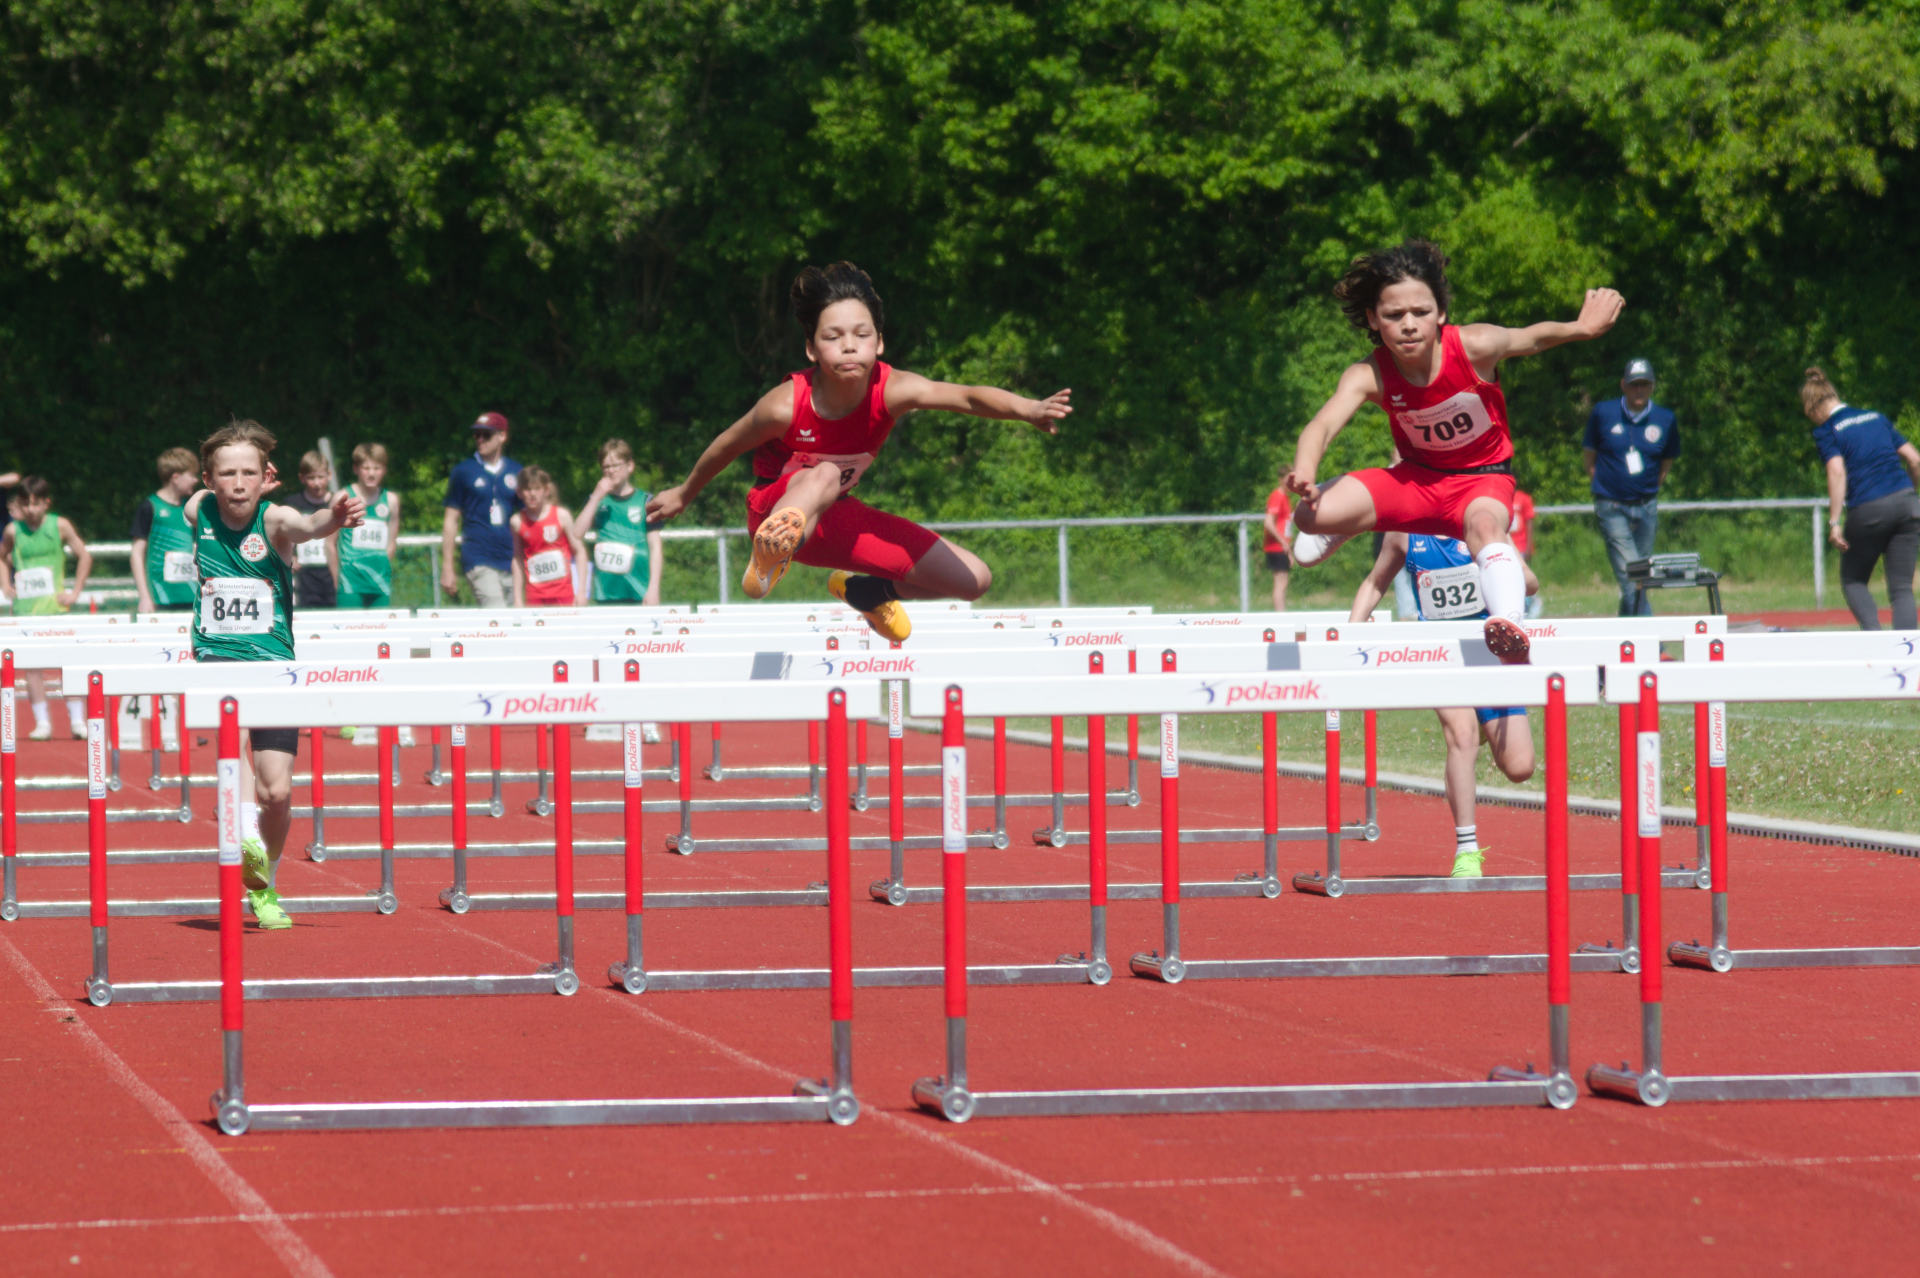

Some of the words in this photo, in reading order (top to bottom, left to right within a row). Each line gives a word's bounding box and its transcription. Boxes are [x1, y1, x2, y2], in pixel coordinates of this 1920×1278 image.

[1413, 412, 1474, 442] 709
[213, 596, 260, 622] 844
[1431, 582, 1478, 608] 932
[841, 656, 916, 677] polanik
[1376, 646, 1449, 667] polanik
[305, 666, 380, 687] polanik
[502, 692, 598, 719] polanik
[891, 691, 900, 726] polanik
[1226, 680, 1321, 706] polanik
[1163, 717, 1175, 763] polanik
[1712, 708, 1724, 752] polanik
[91, 740, 104, 783] polanik
[627, 728, 639, 772] polanik
[947, 776, 963, 832] polanik
[1643, 761, 1657, 817] polanik
[222, 787, 237, 844] polanik
